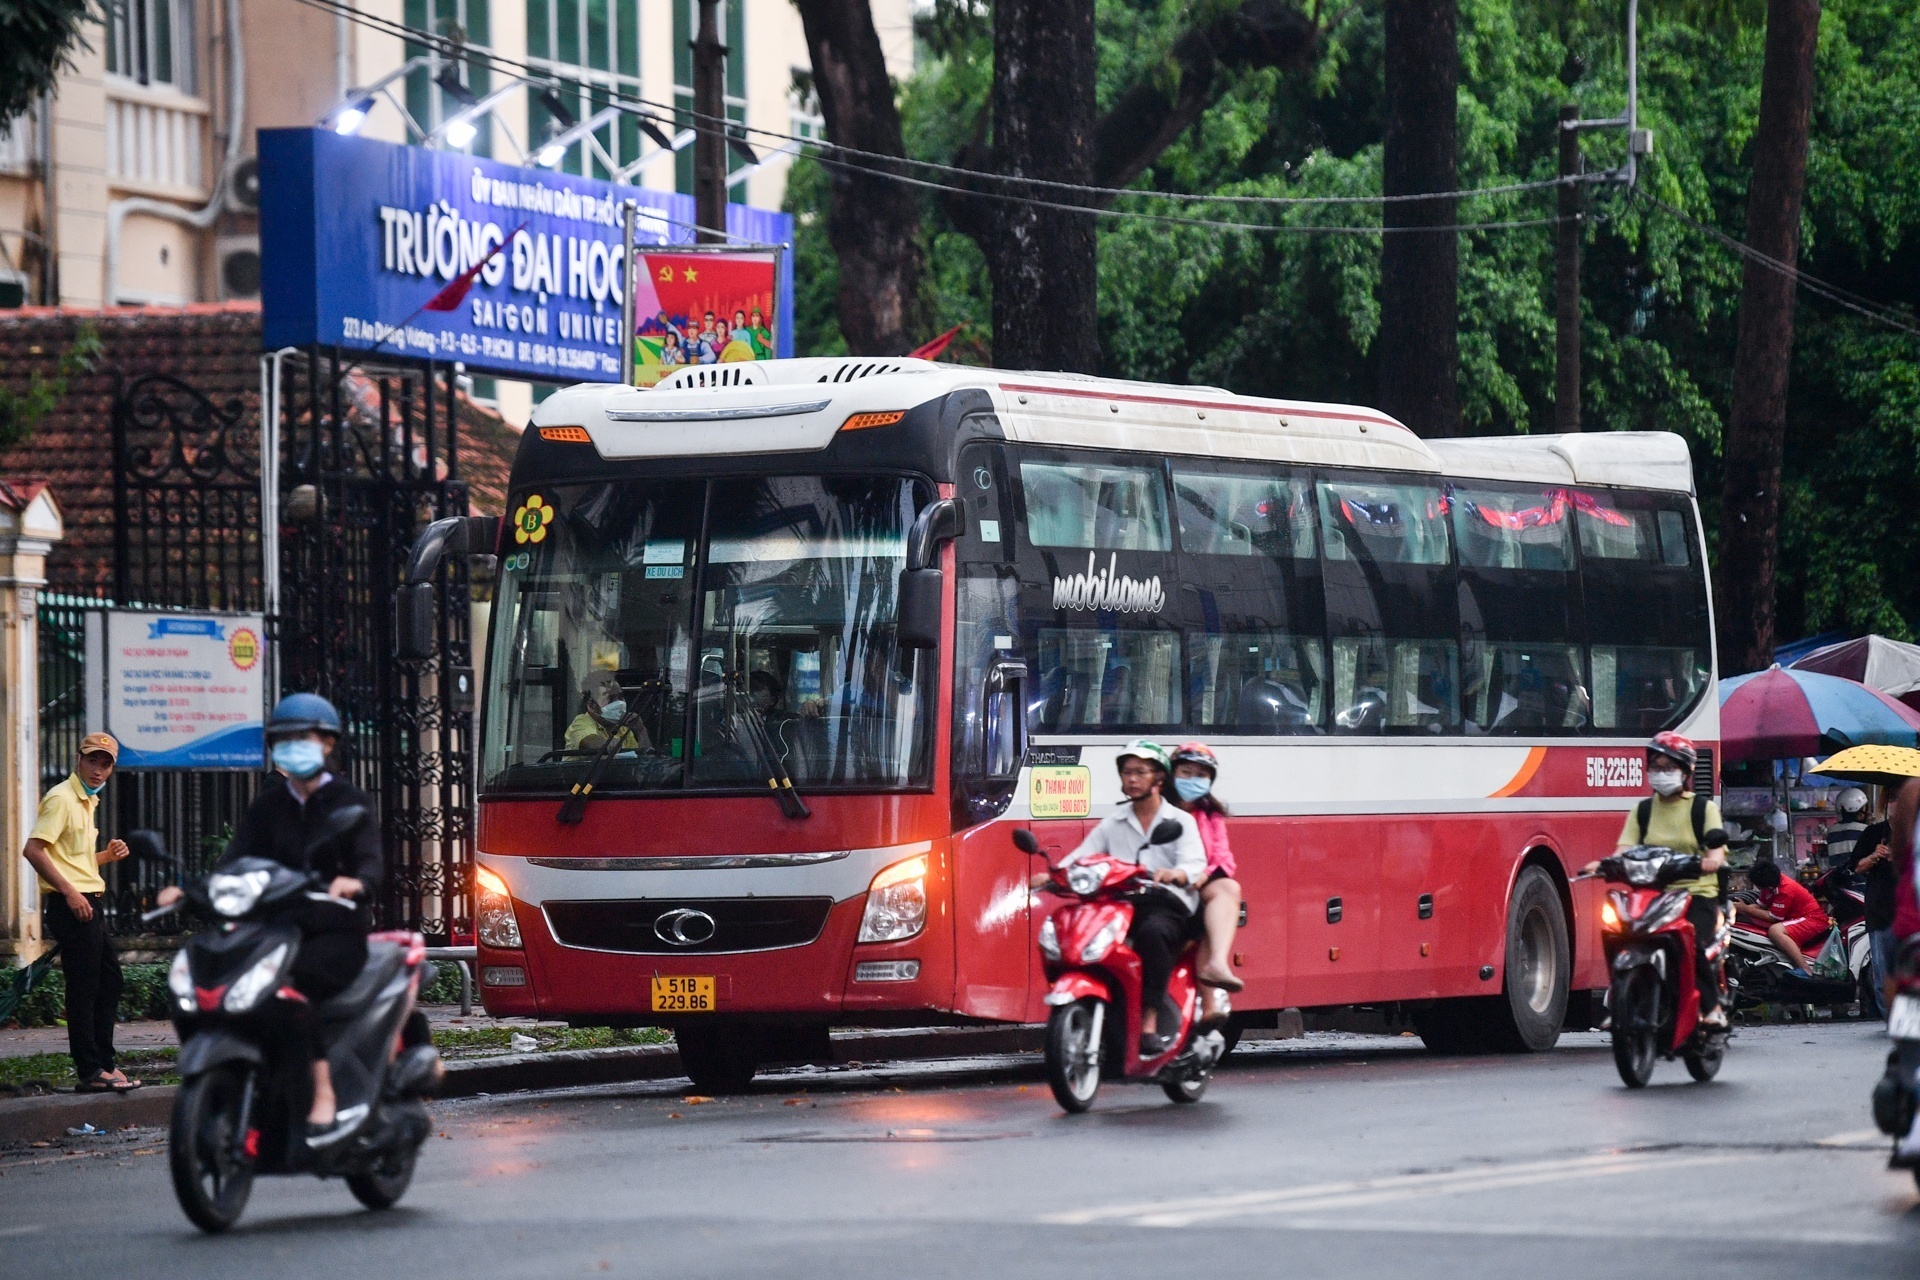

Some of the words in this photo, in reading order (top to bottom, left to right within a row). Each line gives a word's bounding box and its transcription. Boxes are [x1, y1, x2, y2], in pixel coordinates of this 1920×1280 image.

[492, 178, 518, 209] BAN
[519, 181, 553, 215] NHÂN
[554, 186, 582, 221] DÂN
[380, 199, 506, 287] TRƯỜNG
[512, 229, 563, 305] ĐẠI
[472, 297, 549, 336] SAIGON
[361, 319, 374, 341] An
[405, 324, 437, 355] Vương
[526, 514, 537, 530] B
[646, 567, 656, 577] XE
[657, 567, 667, 577] DU
[668, 567, 683, 578] LỊCH
[1053, 550, 1166, 613] mobihome
[658, 995, 708, 1009] 229.86
[669, 978, 696, 993] 51B
